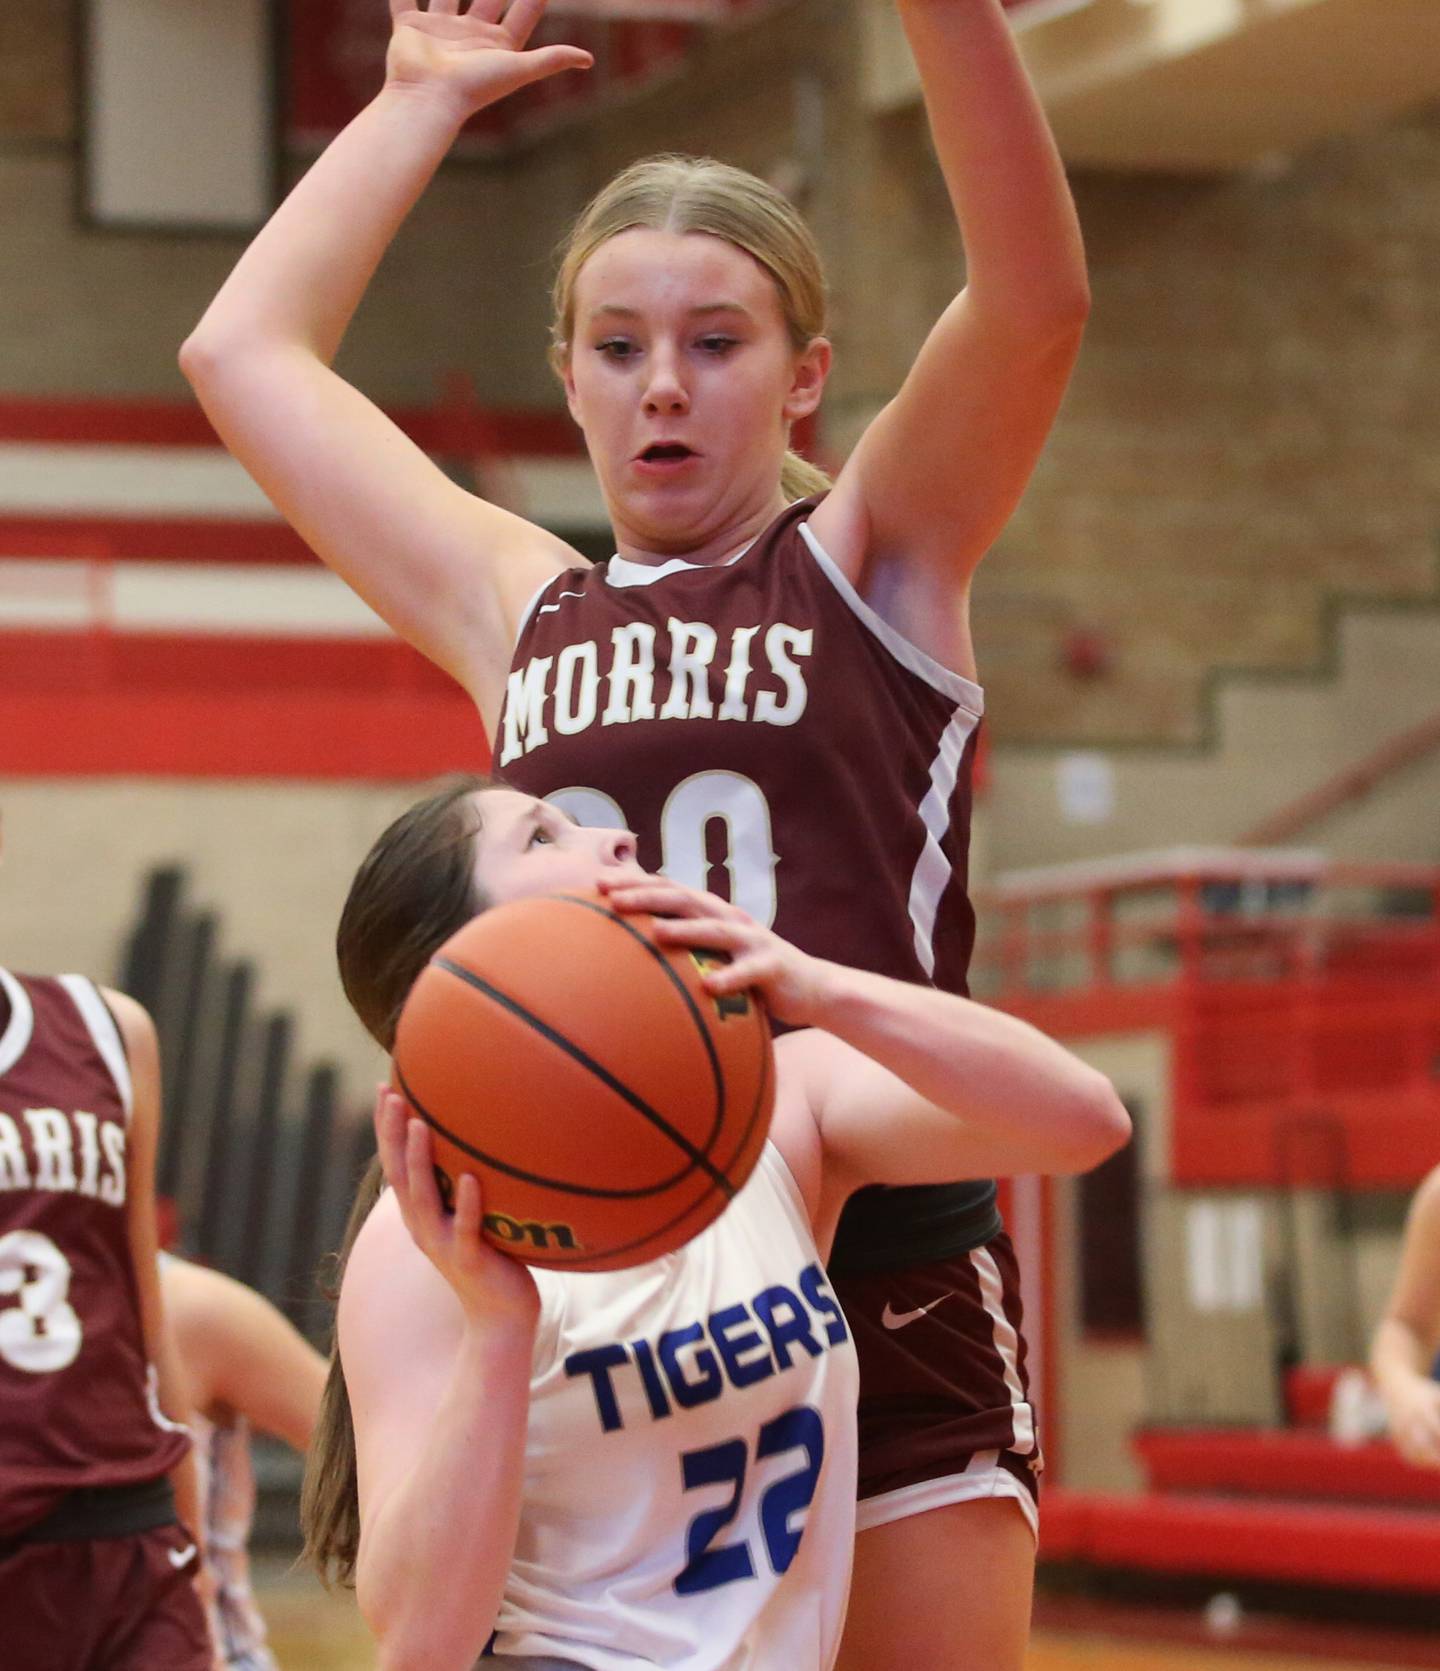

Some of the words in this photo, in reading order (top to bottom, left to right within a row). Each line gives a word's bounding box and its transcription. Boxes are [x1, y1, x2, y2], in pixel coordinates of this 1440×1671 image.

[500, 616, 814, 768] MORRIS
[541, 769, 781, 930] 0
[565, 1263, 849, 1433] TIGERS
[673, 1404, 825, 1597] 22
